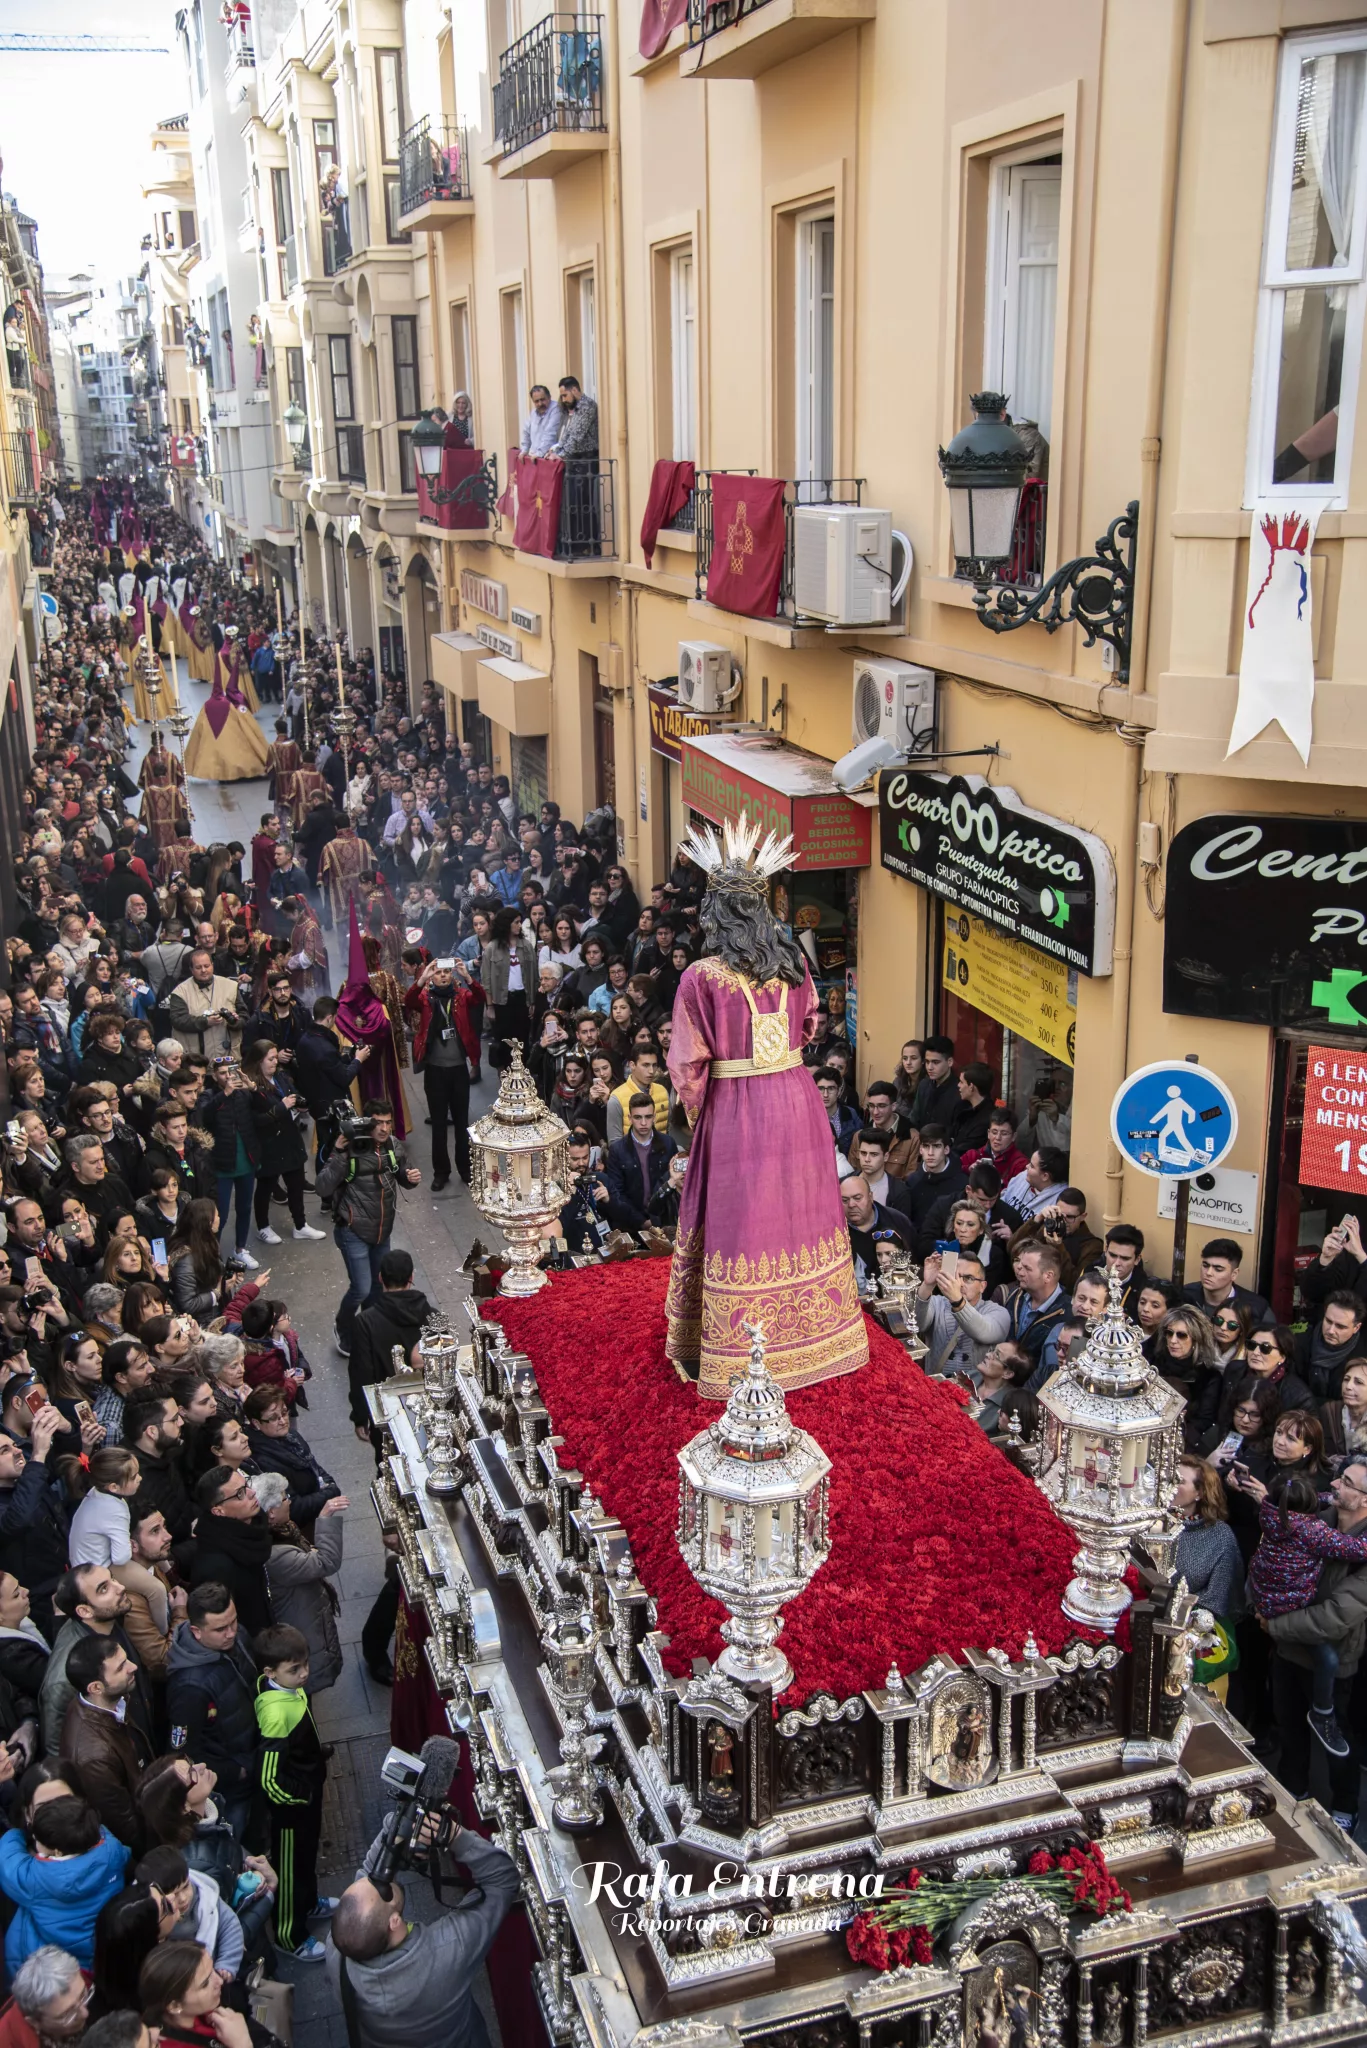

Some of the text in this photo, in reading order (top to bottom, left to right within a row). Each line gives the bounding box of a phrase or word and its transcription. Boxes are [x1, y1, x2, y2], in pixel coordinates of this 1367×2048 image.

[663, 706, 709, 737] TABACOS
[884, 705, 893, 718] LG
[683, 751, 790, 842] Alimentación
[810, 803, 854, 813] FRUTOS
[814, 814, 851, 825] SECOS
[808, 827, 856, 838] BEBIDAS
[800, 838, 864, 851] GOLOSINAS
[806, 851, 858, 863] HELADOS
[938, 836, 1020, 892] Puentezuelas
[936, 862, 1020, 915] GRUPO FARMAOPTICS
[911, 866, 927, 884] LENTES
[927, 875, 934, 888] DE
[933, 878, 958, 900] CONTACTO
[961, 893, 993, 919] OPTOMETRIA
[993, 910, 1016, 932] INFANTIL
[1020, 923, 1066, 957] REHABILITACION
[1067, 946, 1088, 969] VISUAL
[1041, 978, 1053, 995] 350
[1054, 985, 1059, 998] €
[1040, 1002, 1053, 1018] 400
[1053, 1009, 1058, 1022] €
[1038, 1026, 1056, 1047] 500 €
[1313, 1061, 1325, 1077] 6
[1321, 1086, 1367, 1107] CON
[1170, 1191, 1243, 1214] FAMAOPTICS
[1207, 1213, 1249, 1227] PUENTEZUELAS
